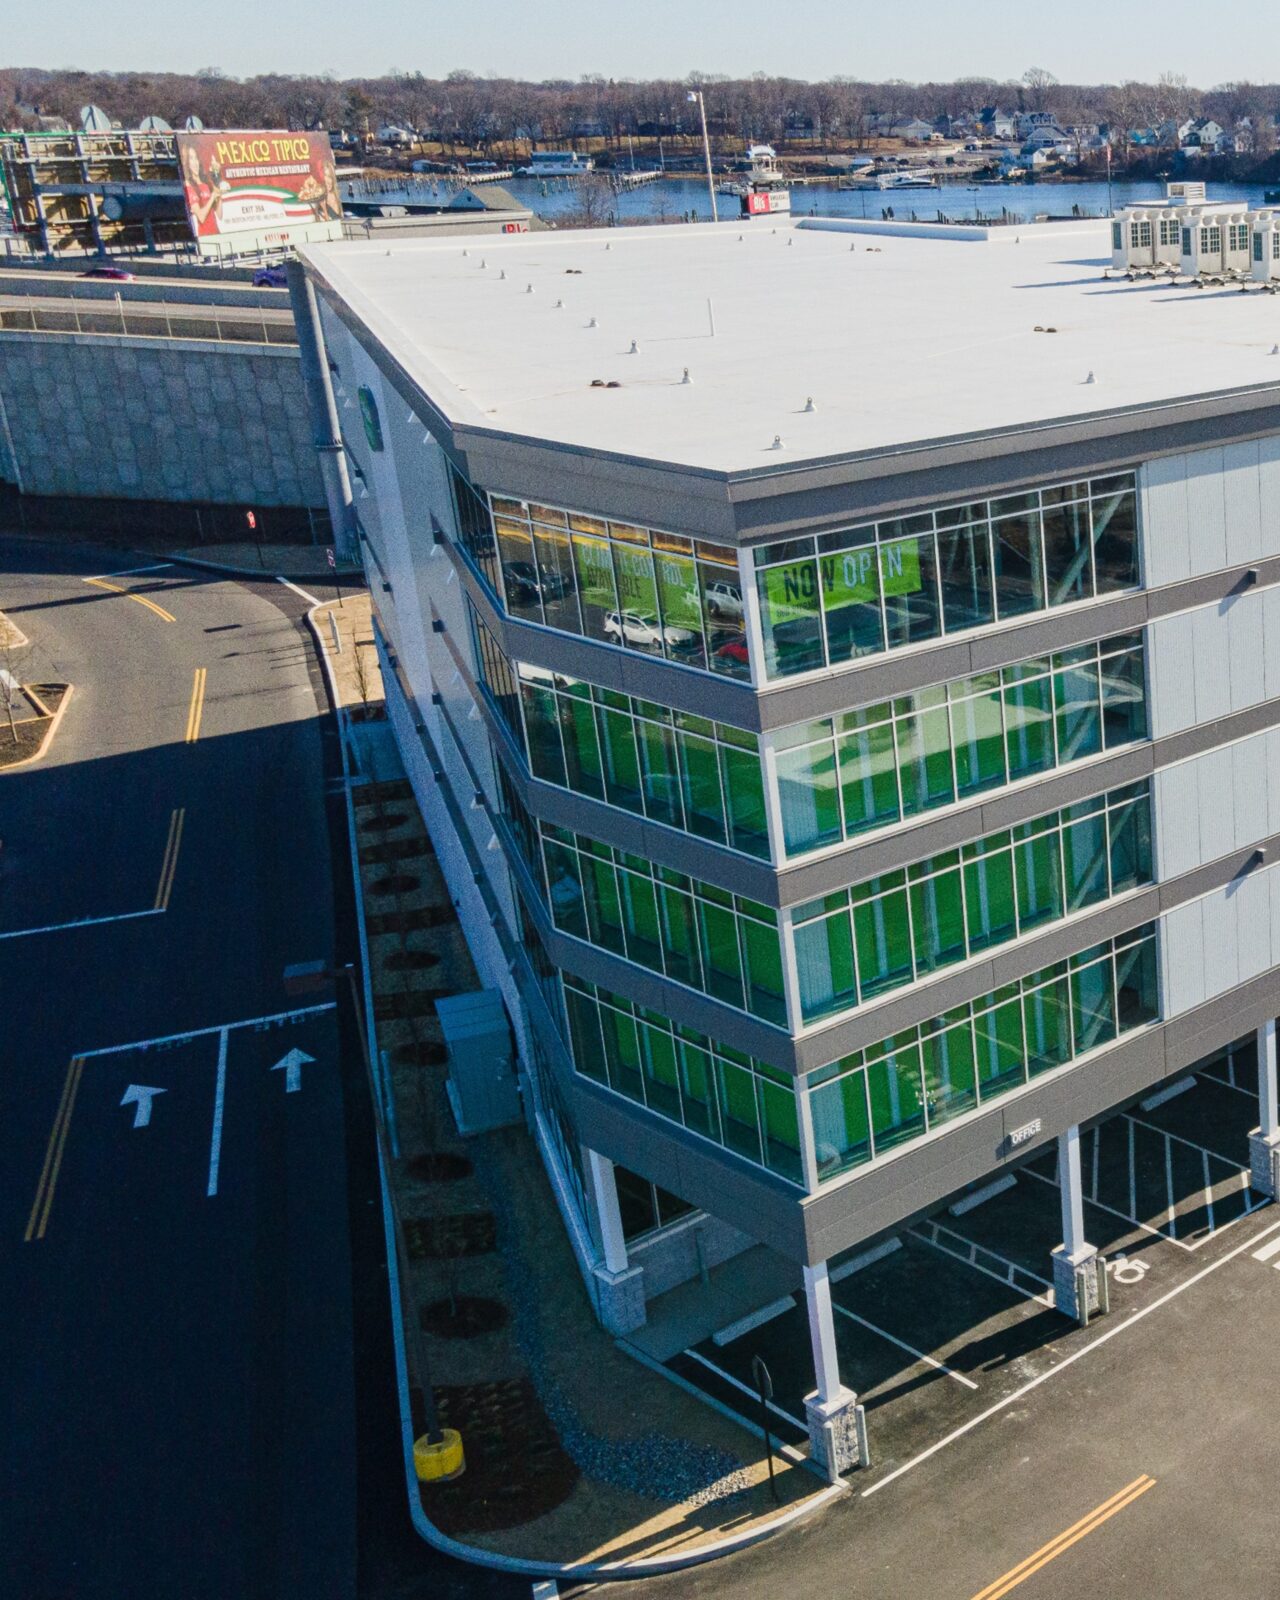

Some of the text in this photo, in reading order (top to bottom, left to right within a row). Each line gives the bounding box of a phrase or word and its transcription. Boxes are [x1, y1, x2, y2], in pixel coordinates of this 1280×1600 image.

[216, 138, 310, 164] MEXICO TIPICO
[241, 205, 253, 214] EXIT
[783, 544, 903, 602] NOW OPN
[1012, 1121, 1041, 1144] OFFICE
